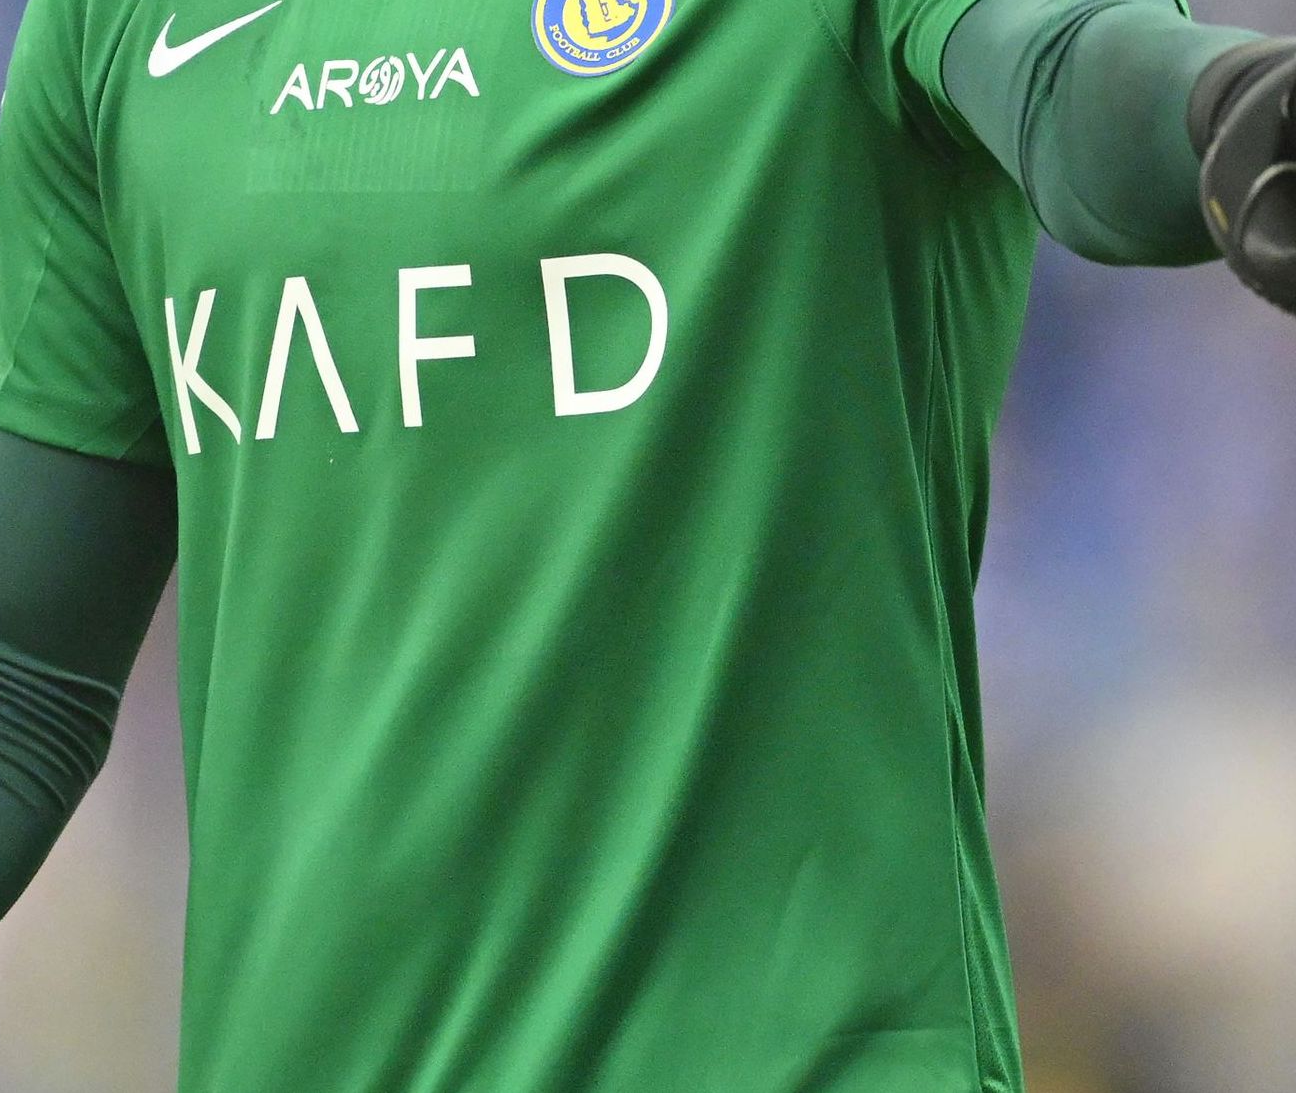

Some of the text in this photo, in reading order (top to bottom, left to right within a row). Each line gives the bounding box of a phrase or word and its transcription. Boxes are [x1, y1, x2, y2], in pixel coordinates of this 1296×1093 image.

[549, 24, 640, 61] FOOTBALL CLUB
[164, 253, 668, 455] KAFD
